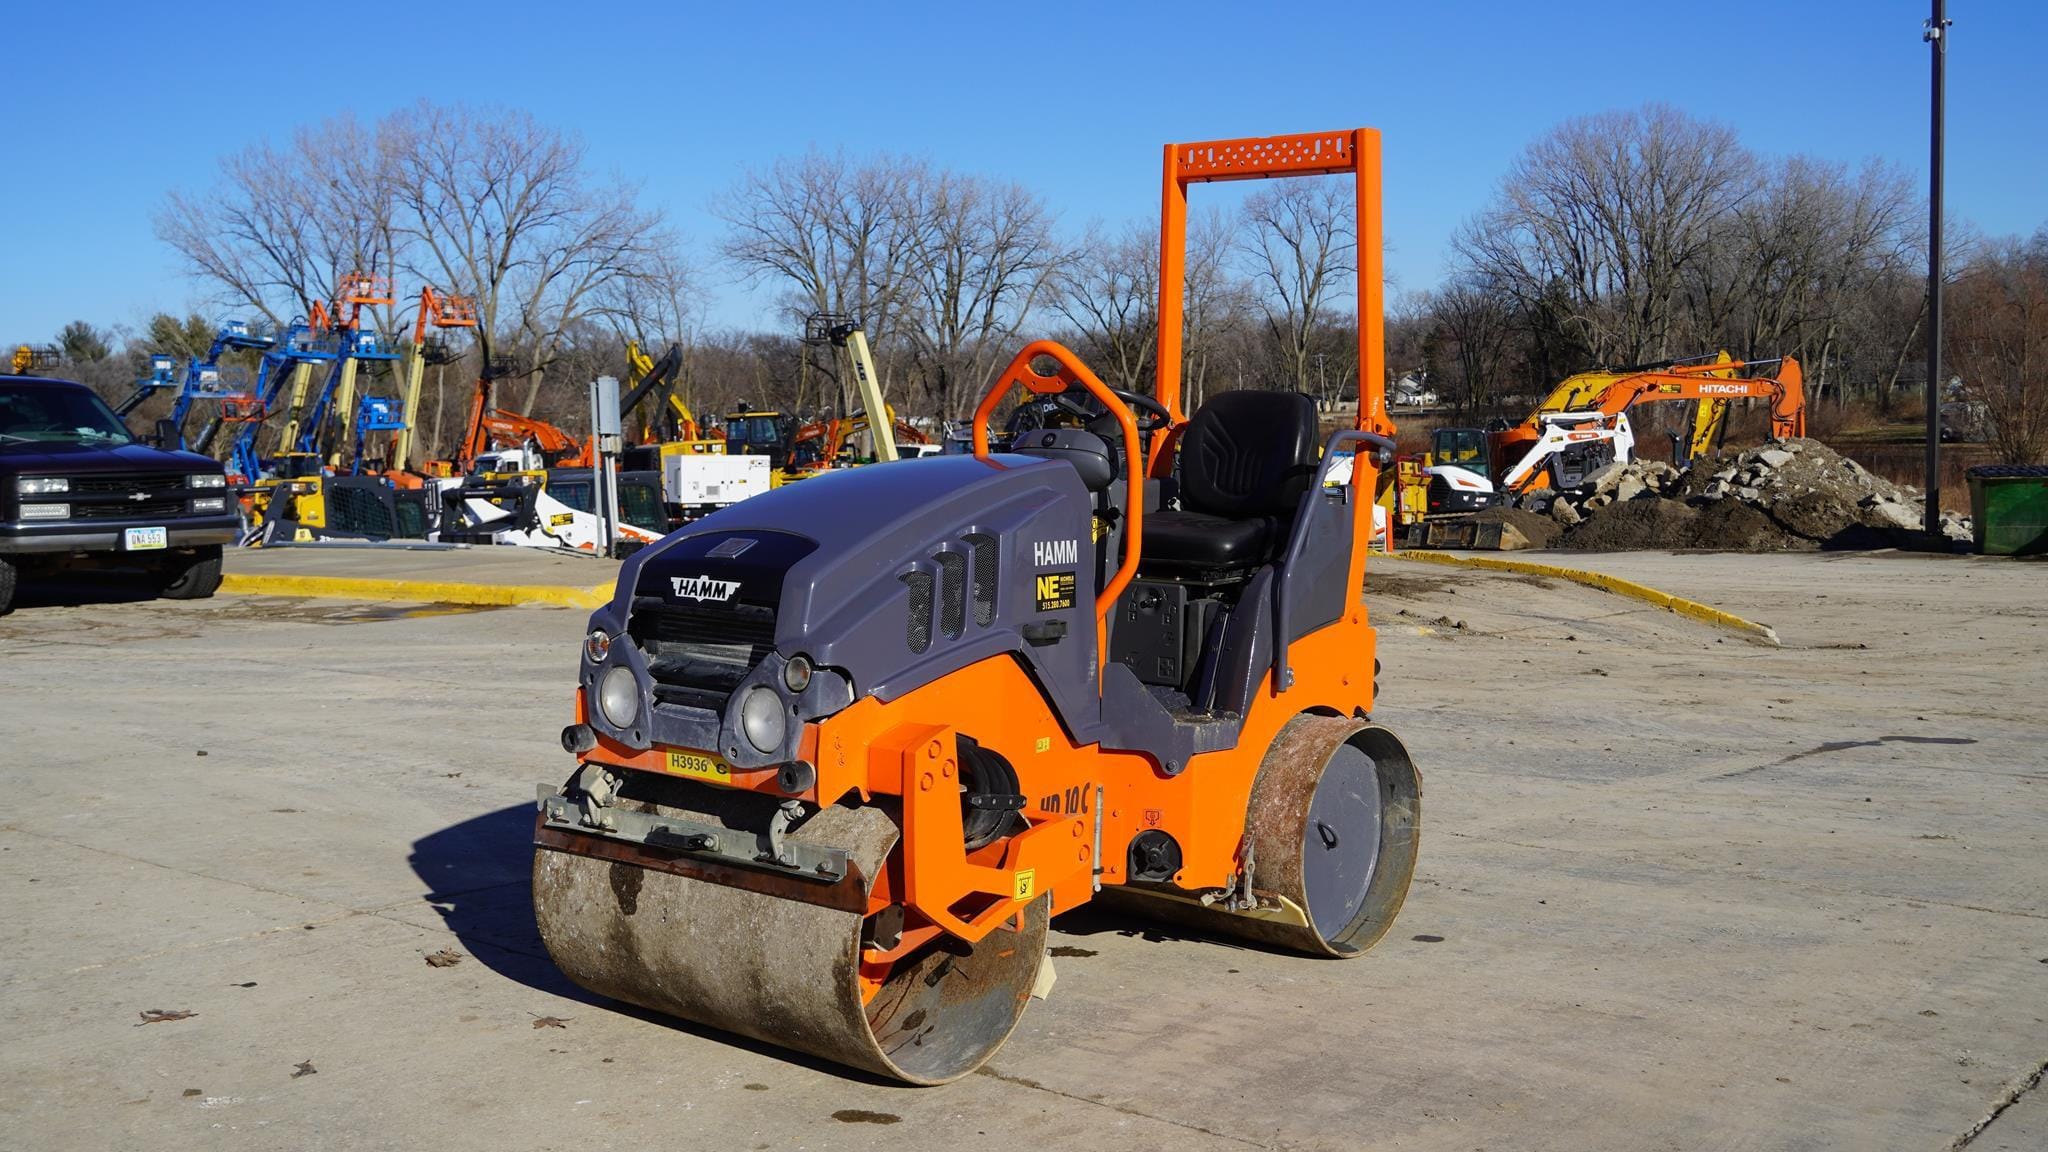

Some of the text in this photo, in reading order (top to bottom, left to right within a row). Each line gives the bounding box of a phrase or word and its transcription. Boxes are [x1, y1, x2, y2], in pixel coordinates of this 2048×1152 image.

[856, 360, 867, 381] JLG
[1699, 384, 1748, 393] HITACHI
[1034, 540, 1077, 567] HAMM
[678, 580, 727, 599] HAMM
[1037, 575, 1060, 600] NE
[672, 754, 708, 773] H3936
[1065, 786, 1079, 814] 10
[1081, 782, 1090, 814] C
